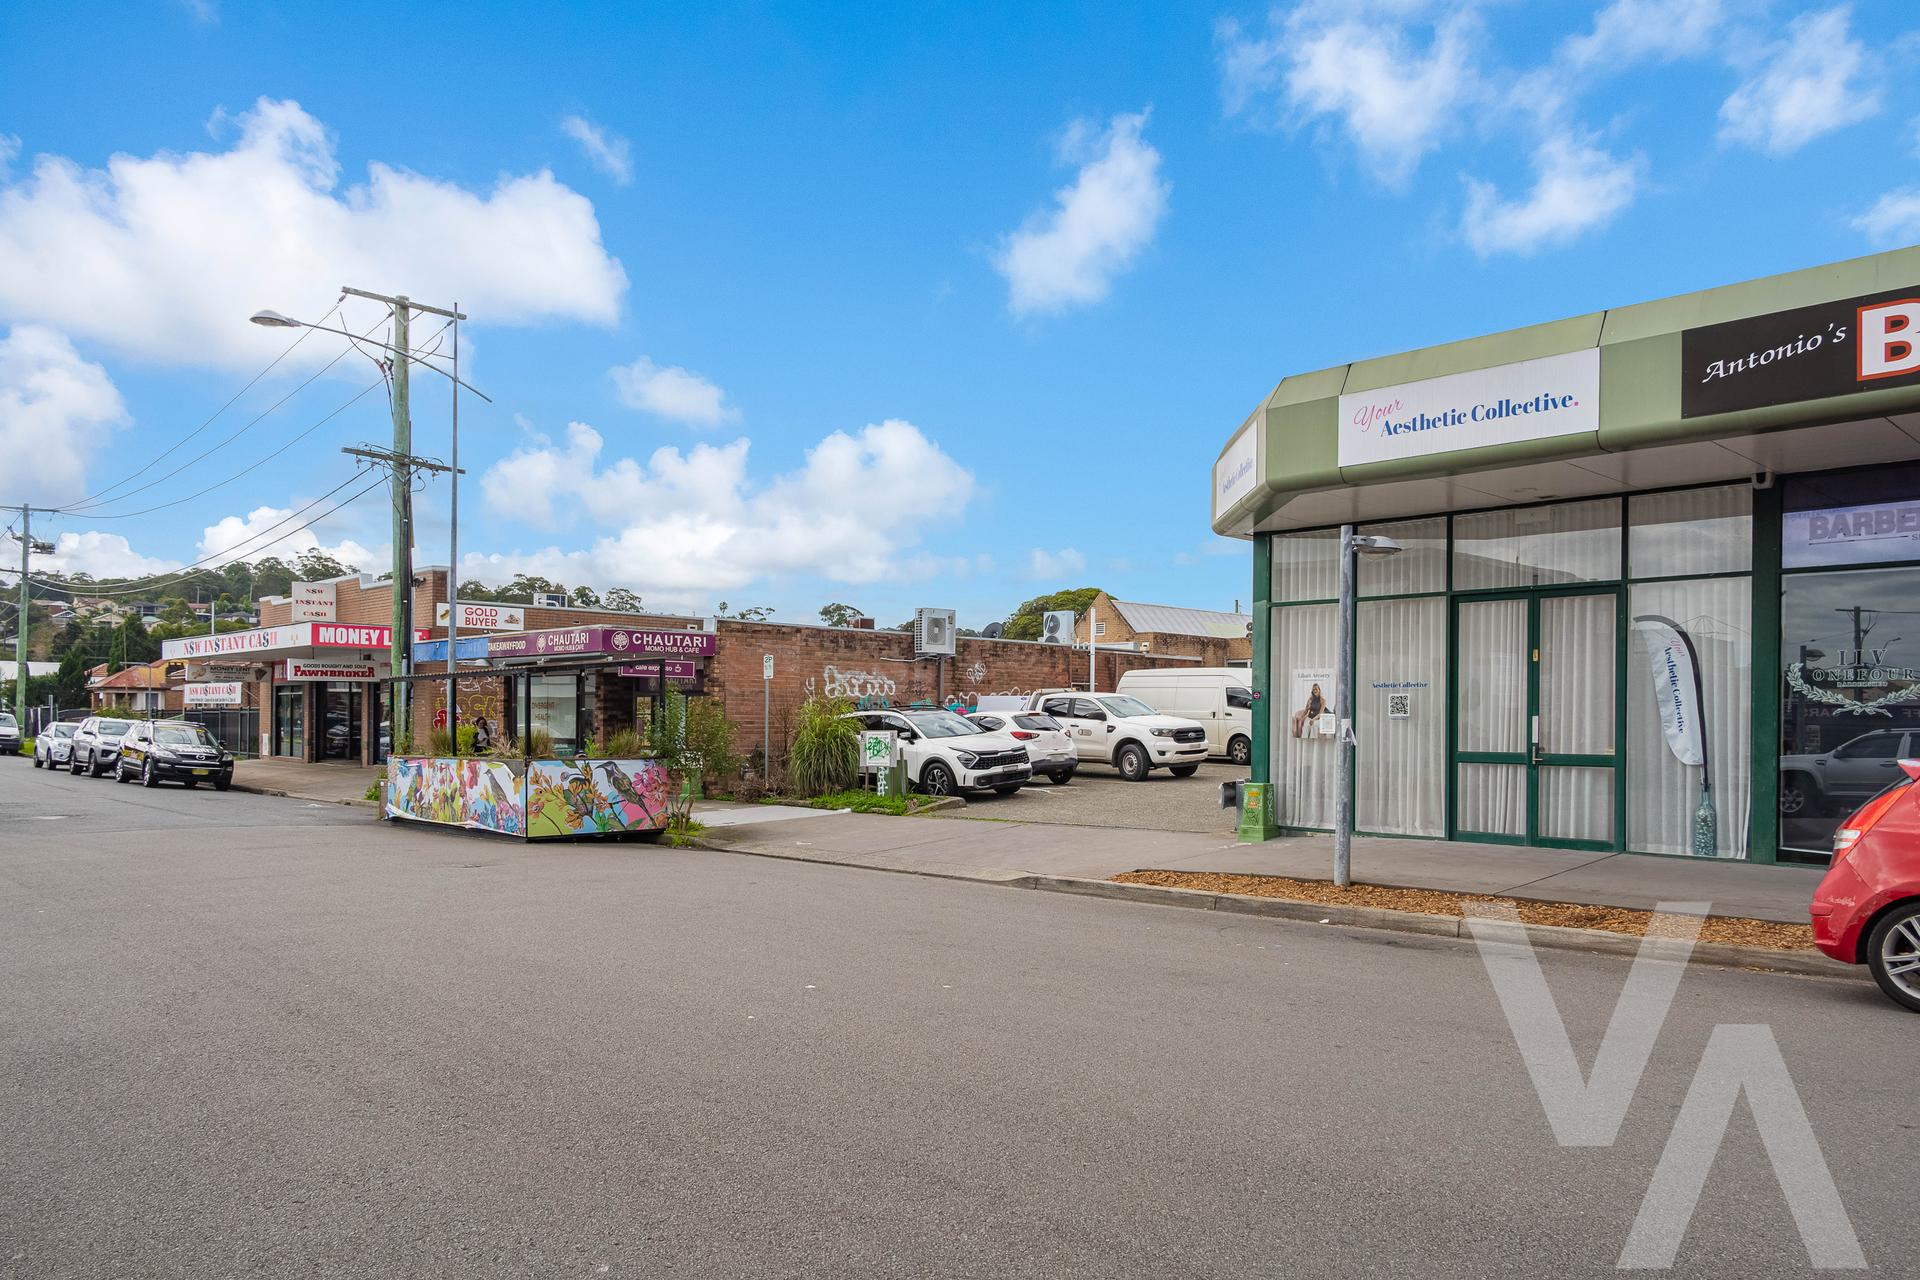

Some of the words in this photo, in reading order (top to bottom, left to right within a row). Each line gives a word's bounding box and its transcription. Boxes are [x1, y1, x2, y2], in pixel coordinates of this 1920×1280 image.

[1702, 323, 1848, 384] Antonio's
[1353, 399, 1405, 433] Your
[1380, 407, 1467, 437] Aesthetic
[1471, 392, 1579, 423] Collective.
[296, 599, 334, 607] INSTANT
[303, 610, 327, 618] CASH
[464, 606, 498, 618] GOLD
[464, 616, 498, 628] BUYER
[184, 639, 202, 656] NSW
[204, 636, 248, 653] INSTANT
[248, 631, 278, 649] CASH
[319, 627, 381, 646] MONEY
[384, 630, 422, 646] LT
[548, 633, 589, 646] CHAUTARI
[632, 633, 707, 648] CHAUTARI
[644, 645, 664, 653] MOMO
[665, 645, 677, 653] HUB
[678, 645, 684, 653] &
[685, 646, 700, 654] CAFE
[1664, 646, 1680, 688] Aesthetic
[1672, 688, 1685, 734] Collective
